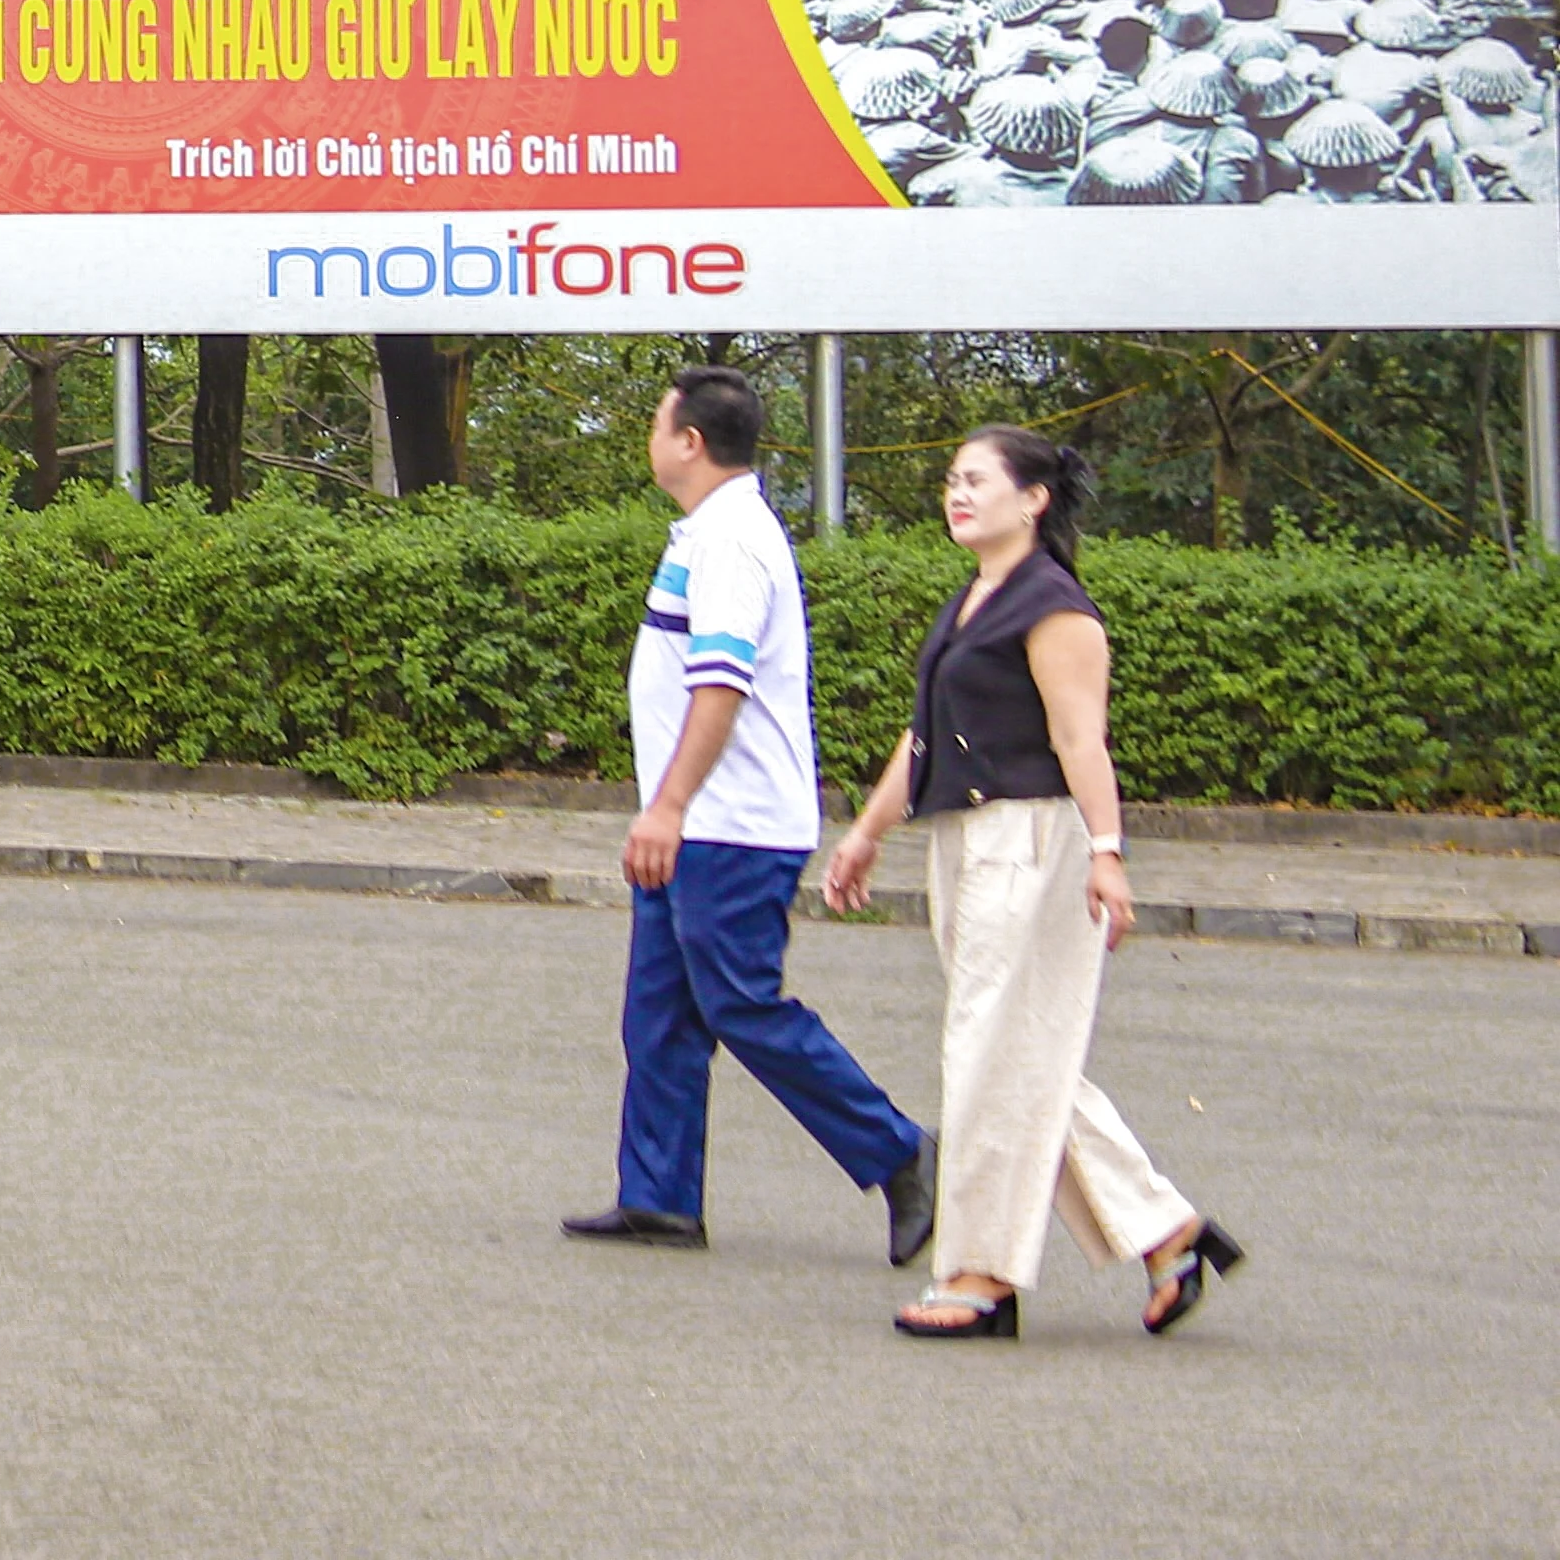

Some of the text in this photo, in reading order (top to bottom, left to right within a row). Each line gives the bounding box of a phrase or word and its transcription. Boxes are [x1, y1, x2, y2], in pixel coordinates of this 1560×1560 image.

[165, 129, 678, 185] Trích lời Chủ tịch Hồ Chí Minh
[267, 222, 747, 298] mobifone
